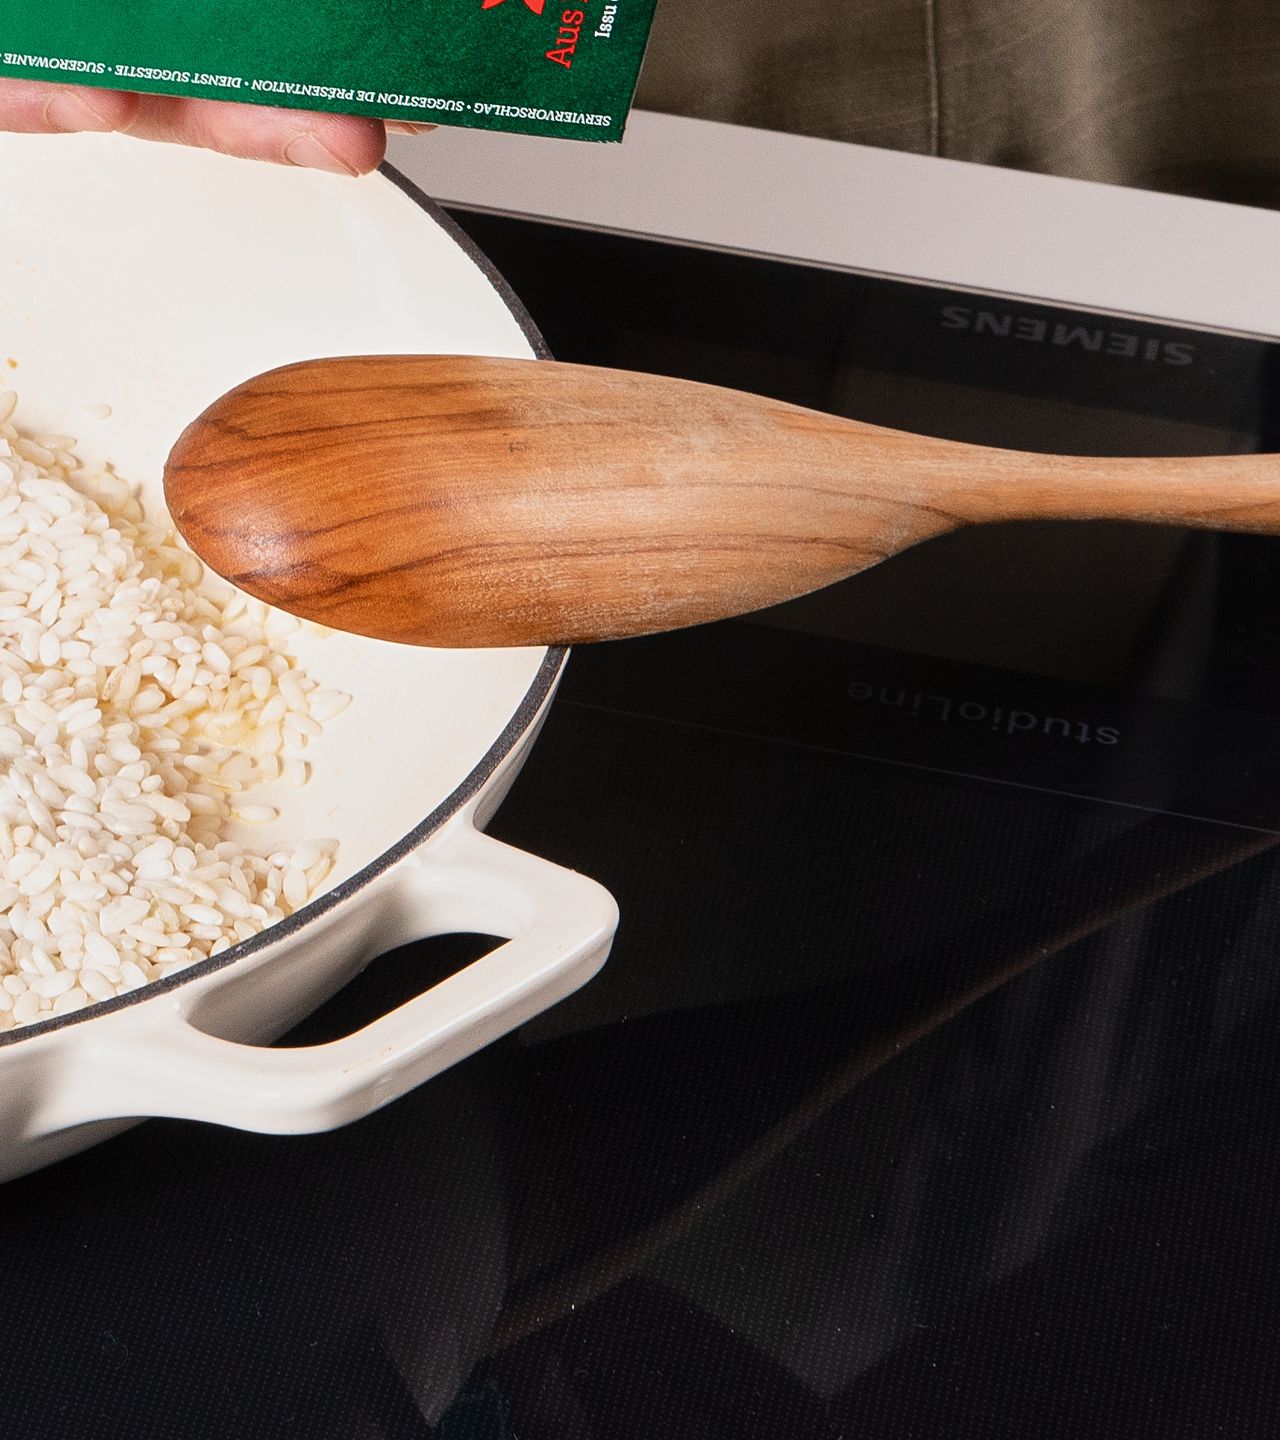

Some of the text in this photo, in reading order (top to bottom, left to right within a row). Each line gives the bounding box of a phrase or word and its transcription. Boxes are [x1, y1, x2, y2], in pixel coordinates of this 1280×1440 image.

[593, 4, 618, 38] Issu
[545, 9, 584, 69] Aus
[2, 52, 106, 74] SUGEROWANIE
[114, 64, 191, 83] SUGGESTIE
[190, 72, 243, 89] DIENST
[250, 79, 355, 101] PRÉSENTATION
[355, 90, 376, 103] DE
[376, 92, 465, 112] SUGGESTION
[473, 102, 612, 127] SERVIERVORSCHLAG
[939, 306, 1197, 367] SIEMENS
[845, 680, 1123, 747] studioLine
